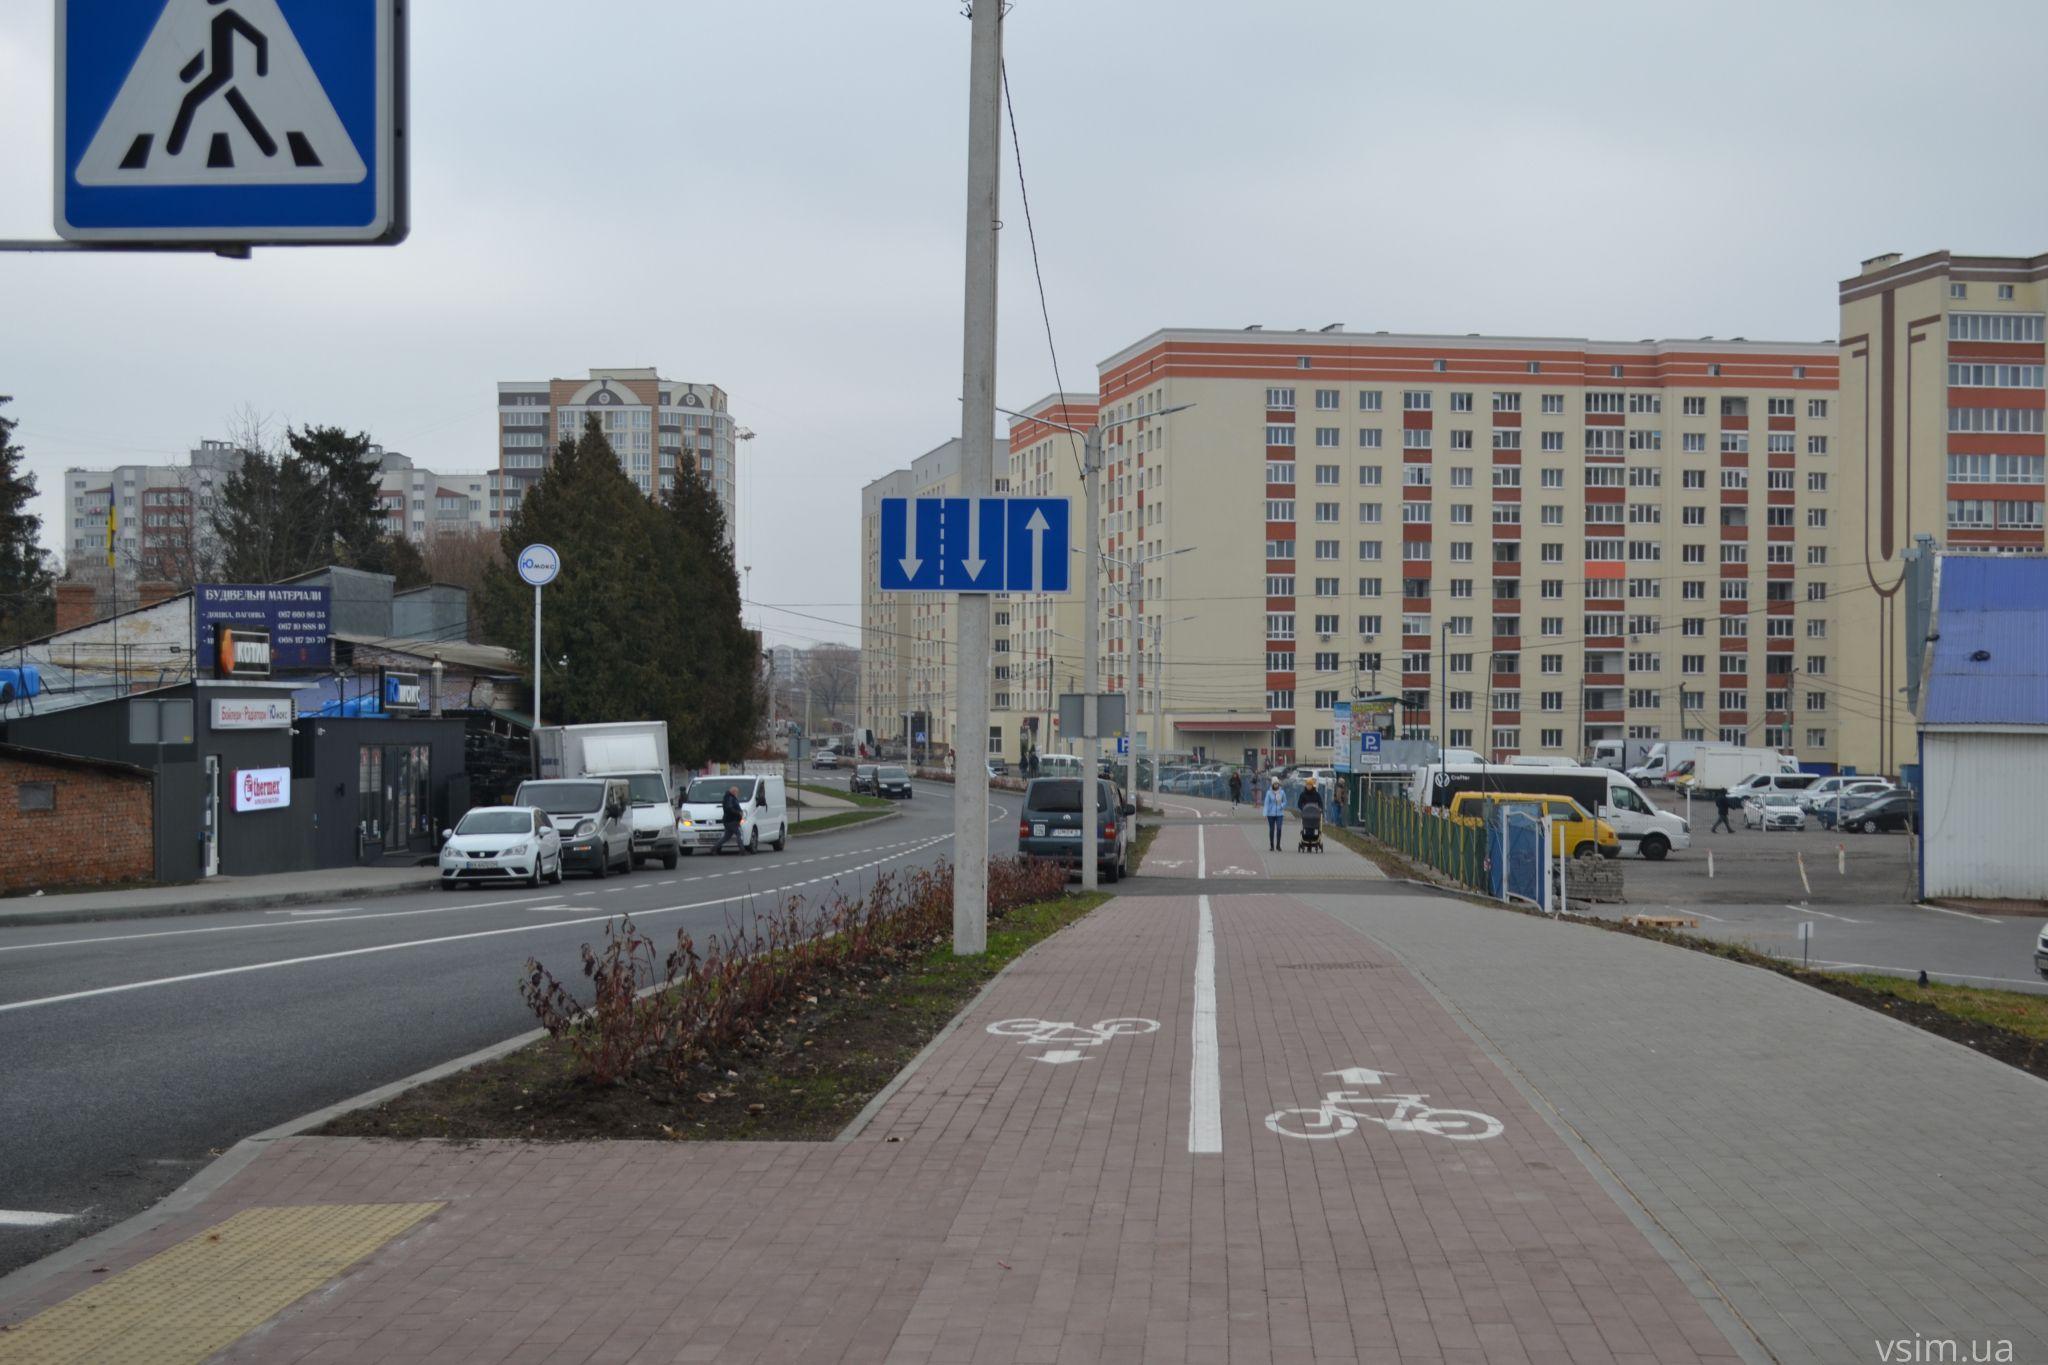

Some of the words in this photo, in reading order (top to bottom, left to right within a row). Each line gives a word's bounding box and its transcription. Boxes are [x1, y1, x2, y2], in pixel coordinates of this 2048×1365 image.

[205, 590, 265, 602] БУДІВЕЛЬНІ
[268, 590, 321, 601] МАТЕРІАЛИ
[1365, 736, 1376, 750] P
[253, 776, 280, 797] thermex
